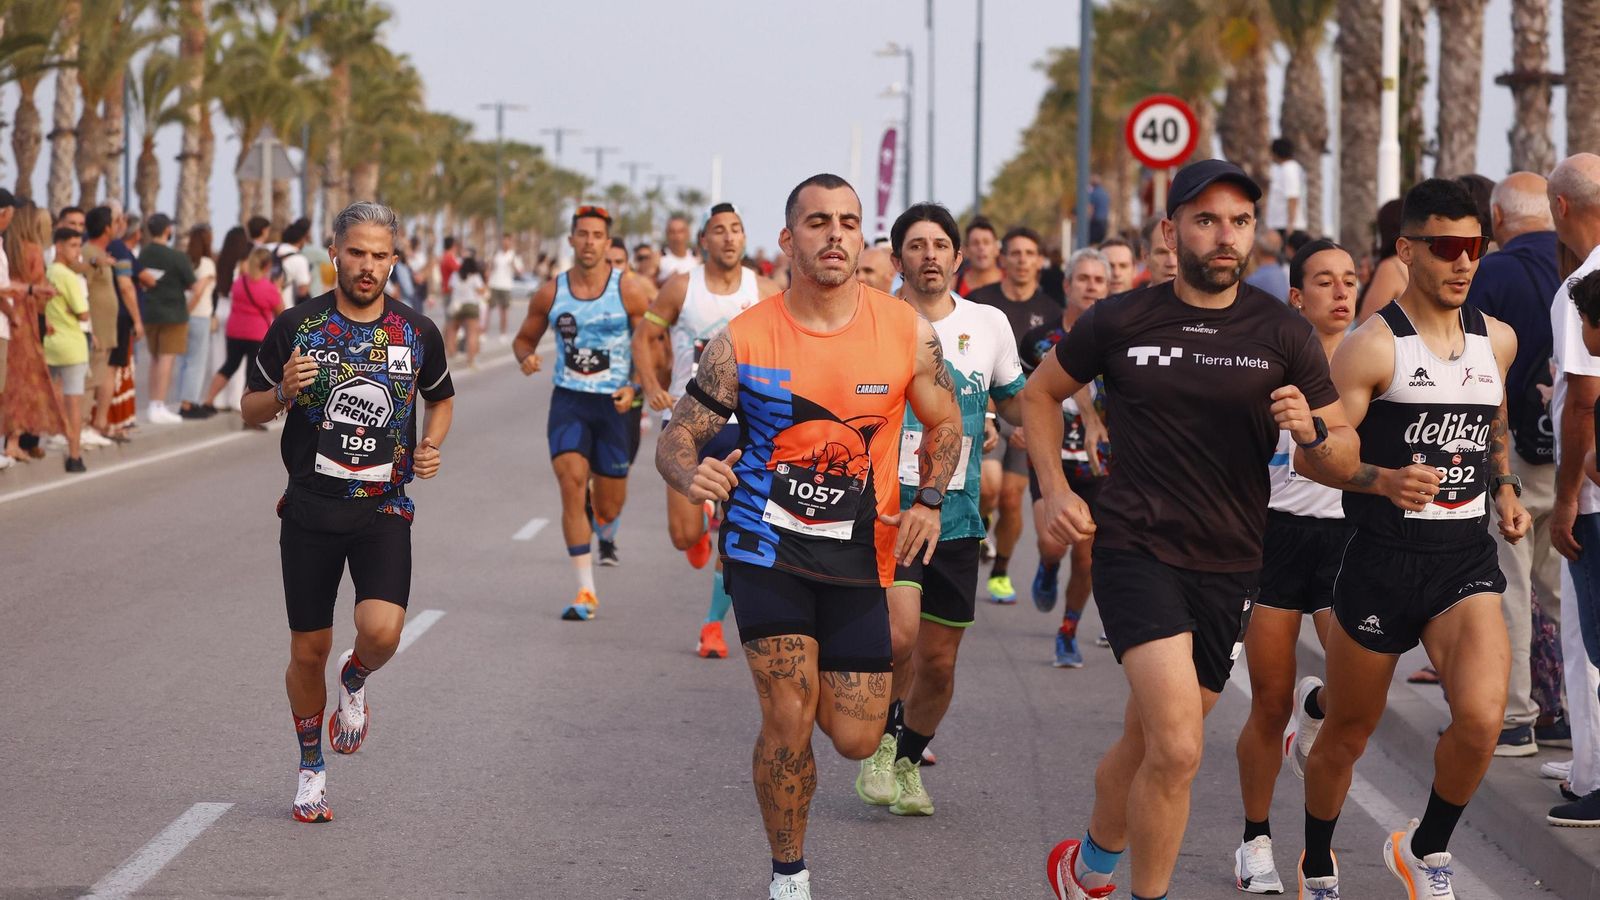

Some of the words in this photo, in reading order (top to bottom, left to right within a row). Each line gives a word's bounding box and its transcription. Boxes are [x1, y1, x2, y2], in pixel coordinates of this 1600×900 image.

[1141, 119, 1178, 144] 40
[1182, 324, 1218, 335] TEAMERGY
[388, 359, 408, 372] AXA
[1193, 353, 1233, 367] Tierra
[1236, 355, 1269, 370] Meta
[857, 384, 888, 394] CARADURA
[337, 392, 386, 418] PONLE
[333, 403, 378, 428] FRENO
[340, 433, 377, 452] 198
[788, 478, 846, 505] 1057
